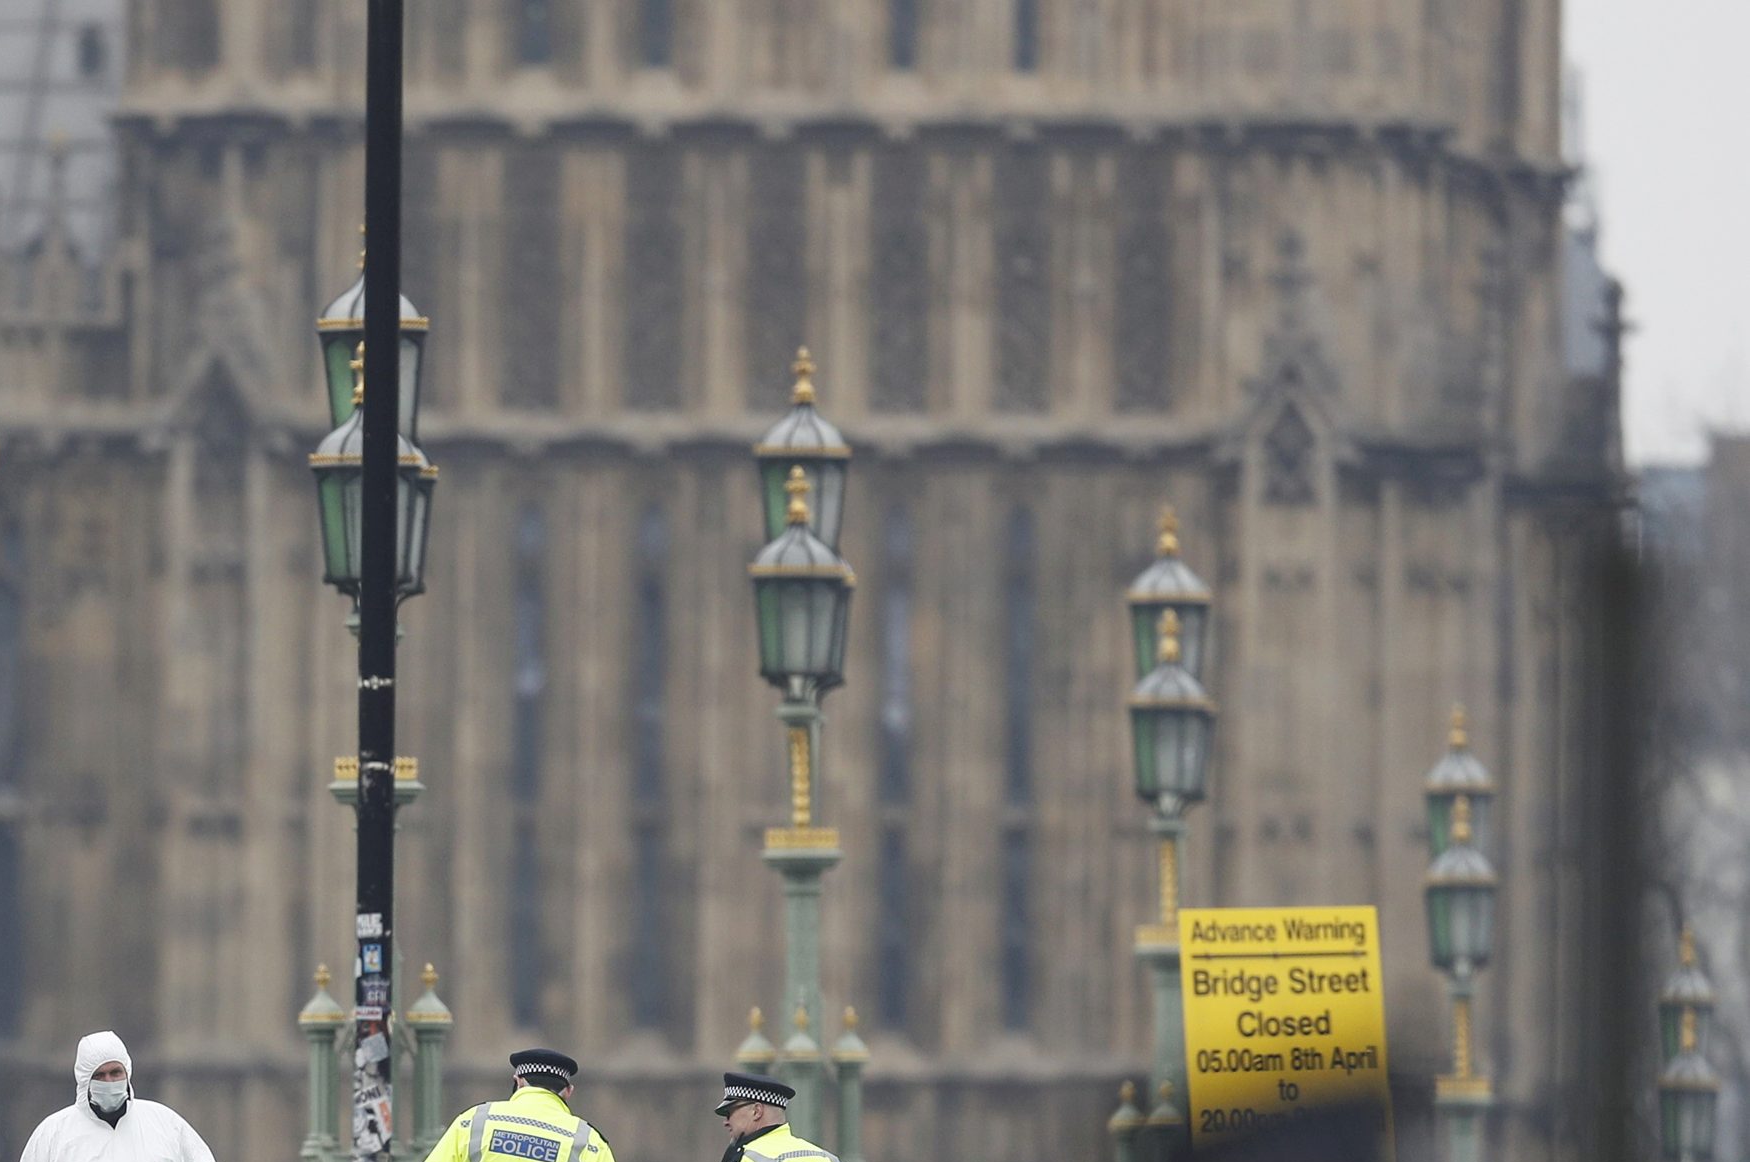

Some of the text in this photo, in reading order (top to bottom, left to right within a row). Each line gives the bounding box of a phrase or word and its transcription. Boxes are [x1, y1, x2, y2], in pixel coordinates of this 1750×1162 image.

[1191, 918, 1366, 945] Advance Warning
[1193, 967, 1370, 1002] Bridge Street
[1237, 1010, 1332, 1038] Closed
[1197, 1046, 1379, 1074] 05.00am 8th April
[1278, 1079, 1299, 1101] to
[490, 1137, 558, 1162] POLICE
[493, 1130, 560, 1150] METROPOLITAN
